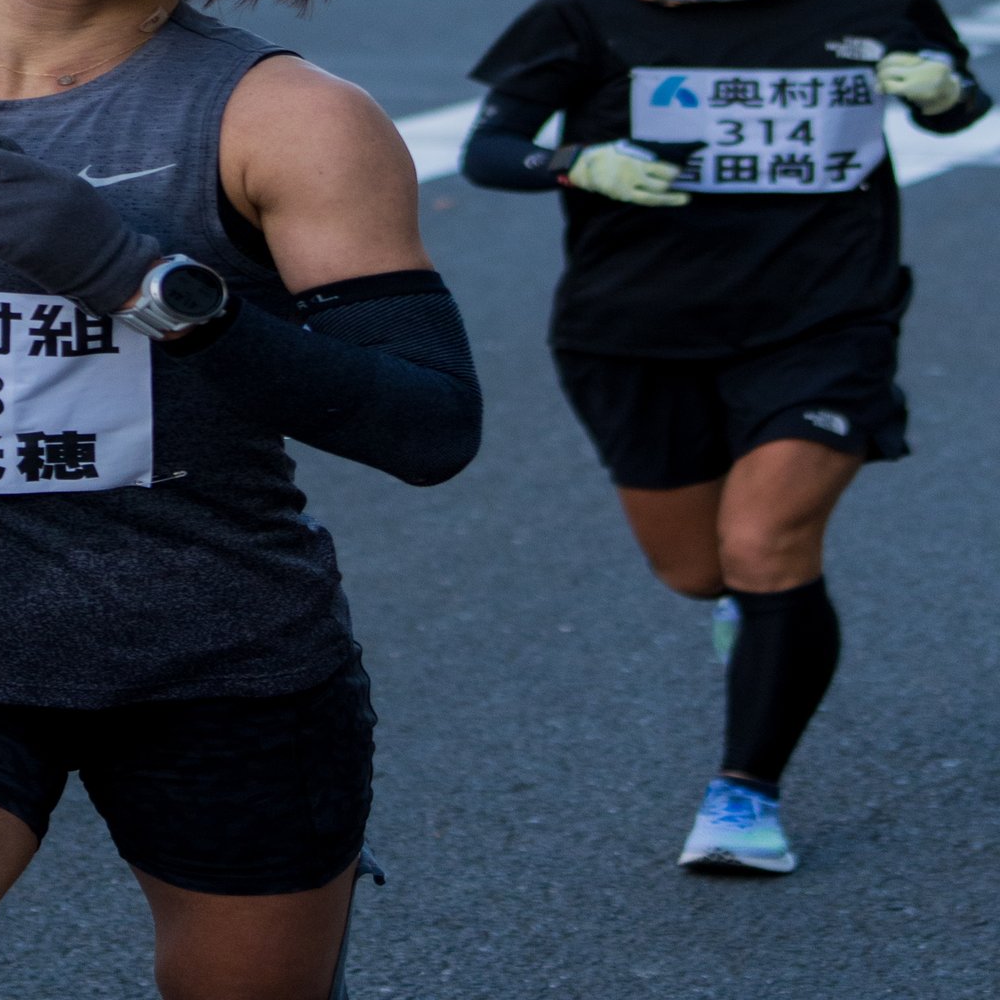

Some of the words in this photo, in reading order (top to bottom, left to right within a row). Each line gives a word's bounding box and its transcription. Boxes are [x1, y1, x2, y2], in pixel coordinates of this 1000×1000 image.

[708, 74, 874, 108] 奥村組
[715, 118, 816, 146] 314
